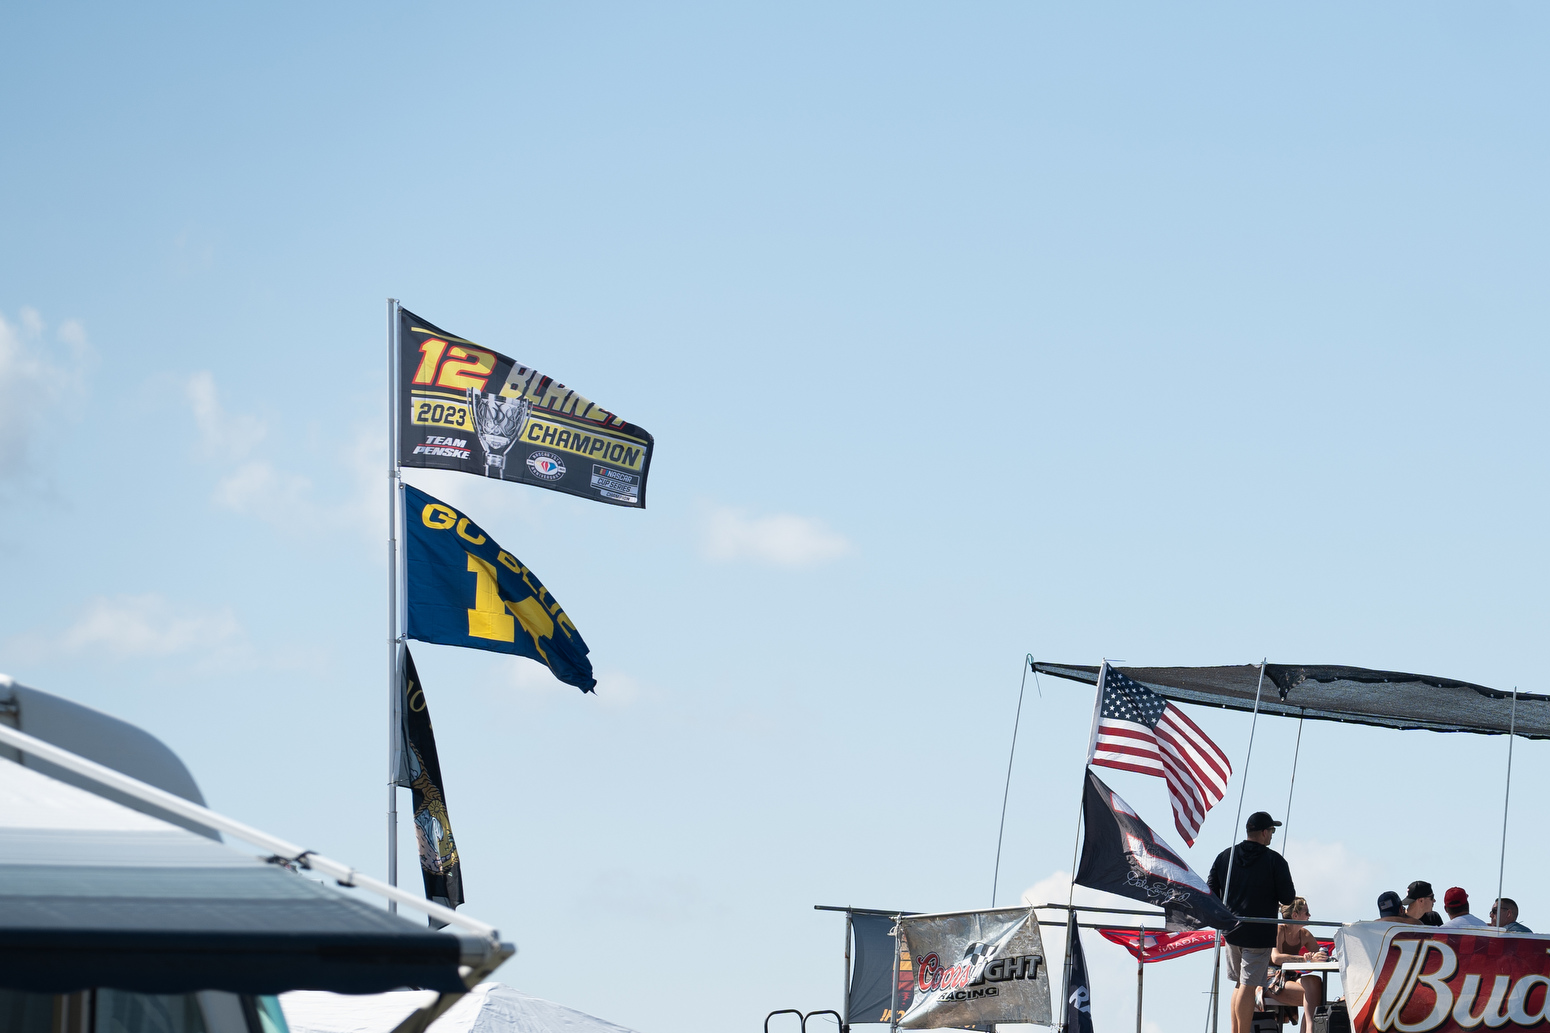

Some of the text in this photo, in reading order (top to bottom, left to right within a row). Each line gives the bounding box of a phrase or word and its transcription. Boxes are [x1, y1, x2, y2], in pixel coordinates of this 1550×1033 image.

[411, 337, 498, 391] 12
[500, 361, 627, 427] BLAN
[416, 402, 467, 427] 2023
[425, 435, 467, 448] TEAM
[527, 423, 641, 469] CHAMPION
[413, 446, 470, 460] PENSKE
[597, 478, 631, 493] CUP SERIES
[608, 471, 632, 483] NASCAR
[916, 951, 972, 994] Coors
[937, 986, 999, 1002] RACING
